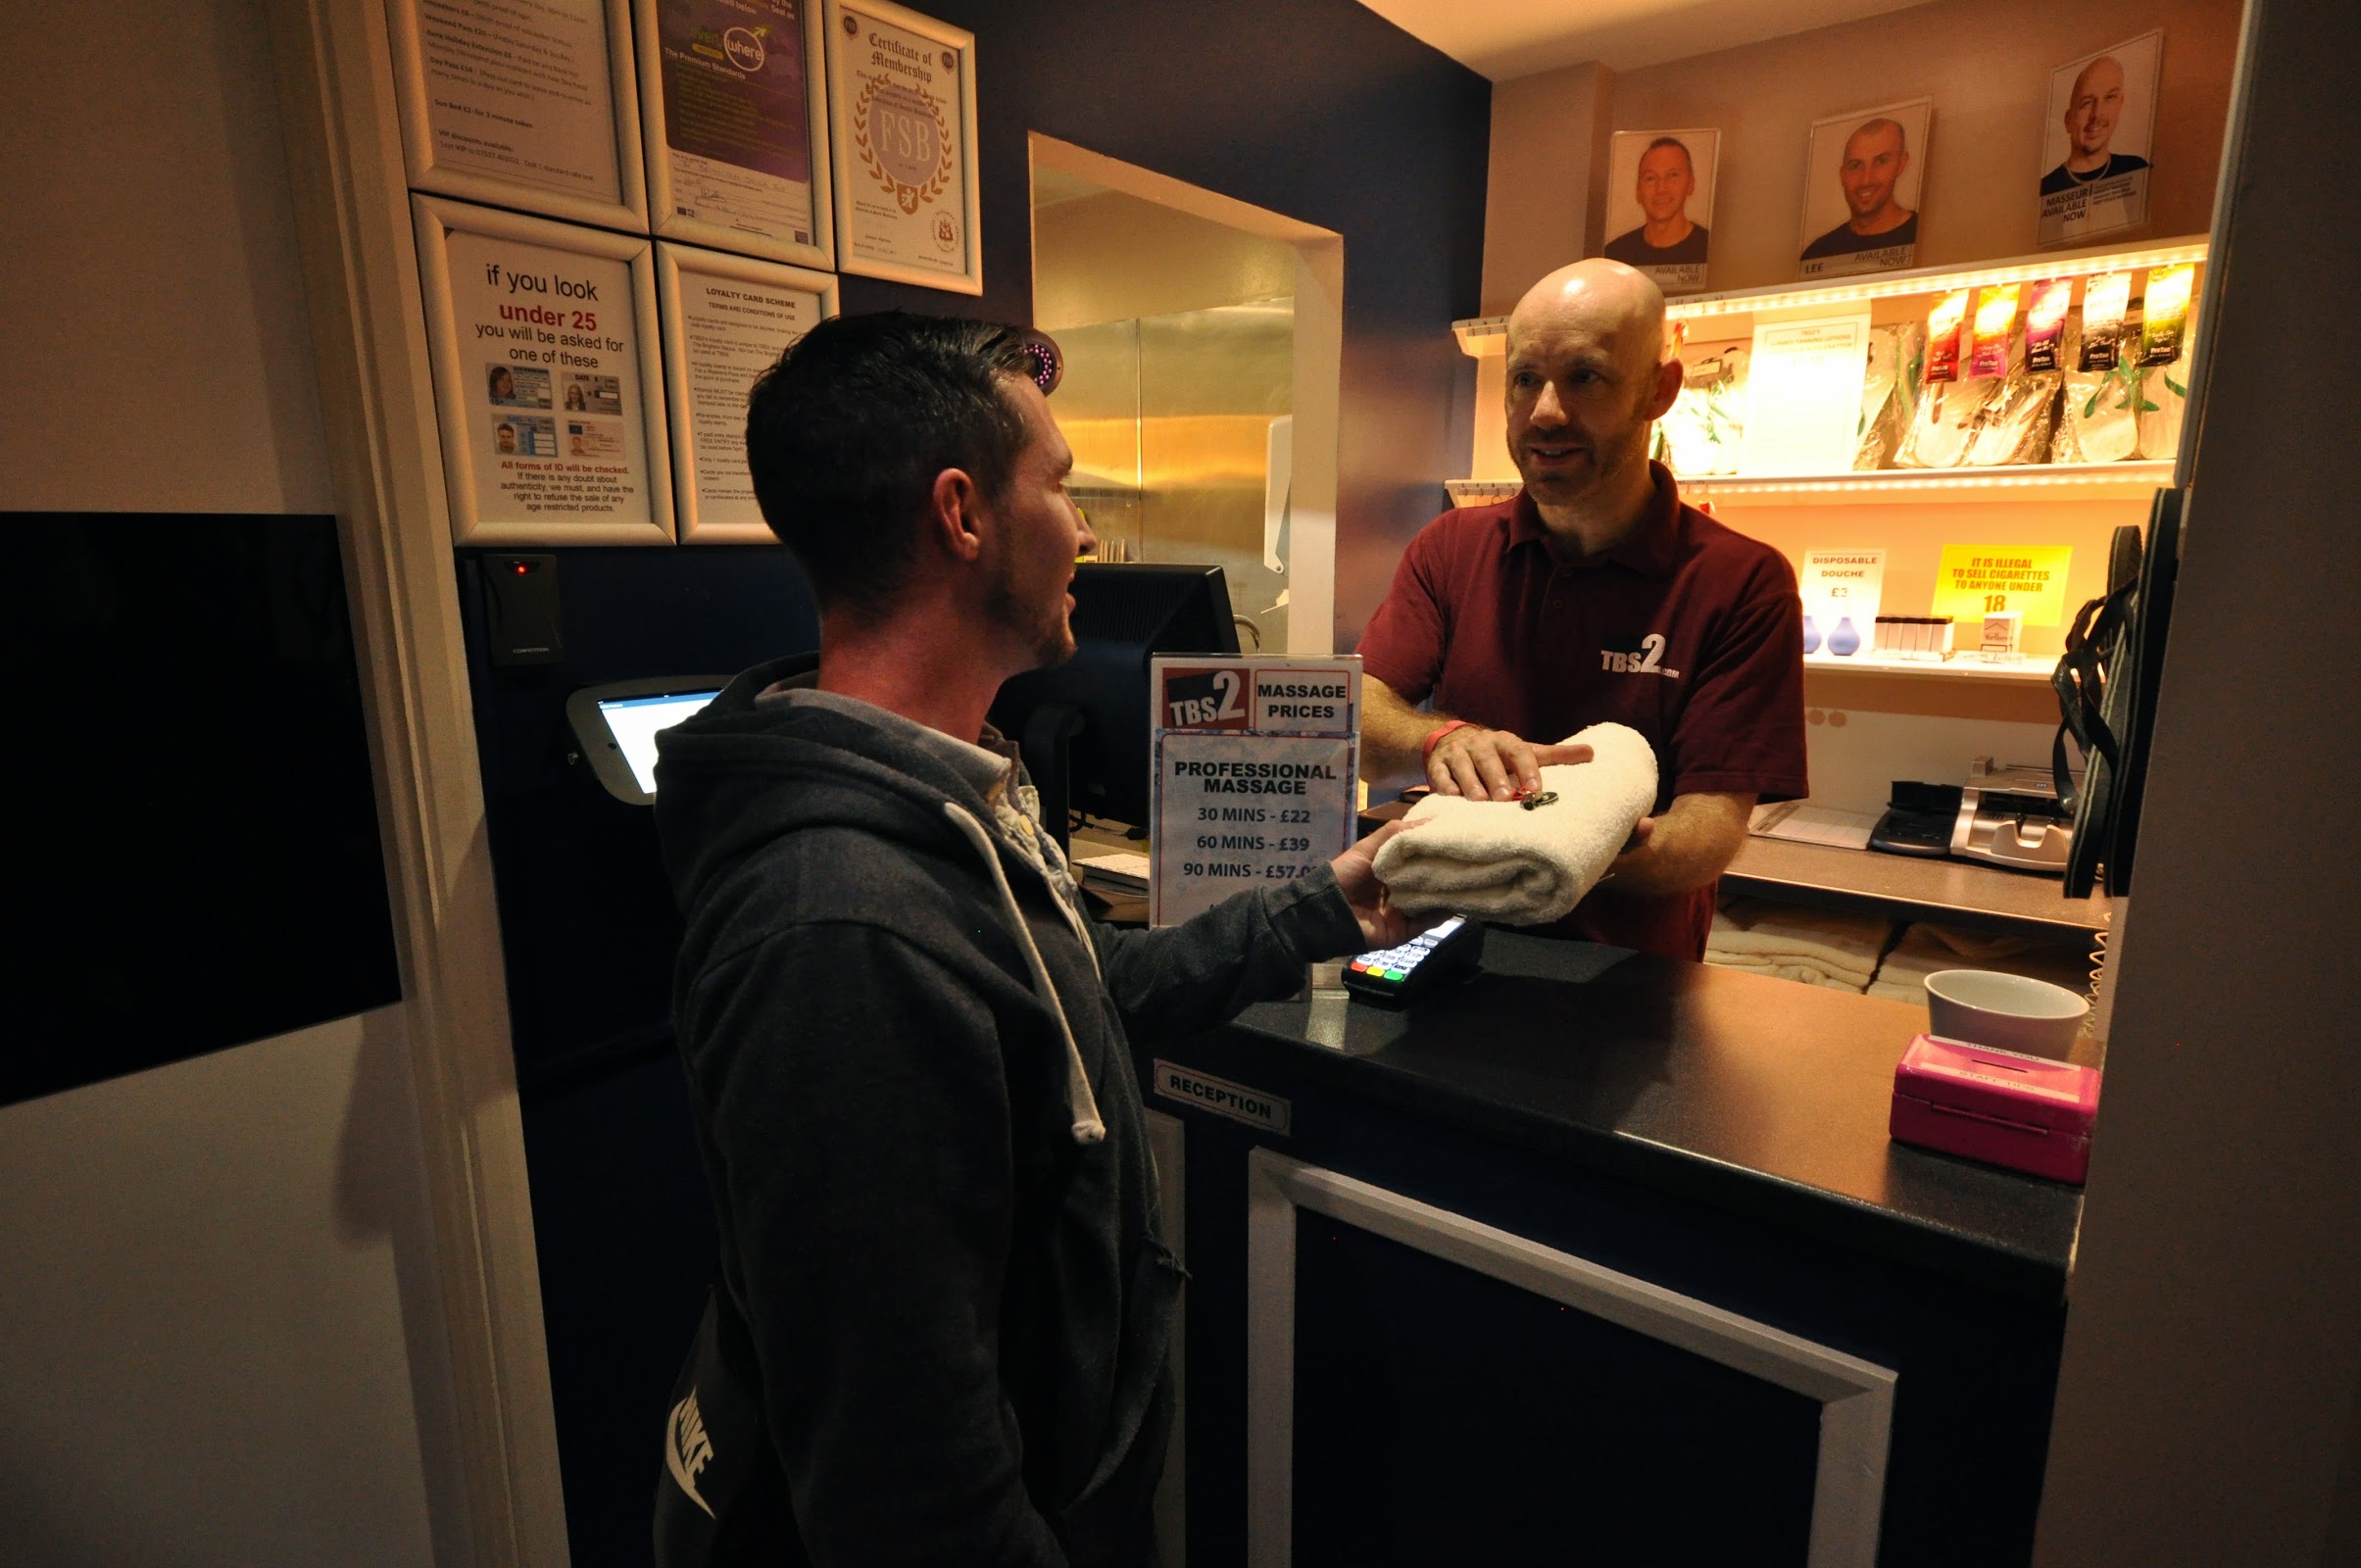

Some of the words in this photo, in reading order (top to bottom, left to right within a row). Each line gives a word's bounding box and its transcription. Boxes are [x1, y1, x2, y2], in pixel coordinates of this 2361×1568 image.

[726, 40, 762, 61] where
[868, 32, 920, 62] Certificate
[922, 52, 932, 67] of
[664, 47, 678, 58] The
[679, 53, 712, 69] Premium
[712, 63, 746, 80] Standards
[870, 51, 932, 84] Membership
[880, 109, 931, 162] FSB
[2045, 187, 2089, 207] MASSEUR
[2041, 199, 2088, 219] AVAILABLE
[2062, 209, 2087, 222] NOW
[1853, 246, 1907, 263] AVAILABLE
[1654, 265, 1700, 274] AVAILABLE
[1805, 263, 1824, 274] LEE
[1880, 255, 1906, 267] NOW
[486, 263, 500, 287] if
[507, 271, 548, 294] you
[554, 274, 599, 302] look
[1677, 273, 1700, 282] NOW
[706, 287, 741, 300] LOYALTY
[742, 294, 763, 305] CARD
[765, 297, 797, 310] SCHEME
[499, 305, 566, 327] under
[571, 311, 597, 331] 25
[708, 302, 729, 312] TERMS
[729, 305, 742, 314] AND
[742, 307, 776, 319] CONDITIONS
[784, 314, 796, 322] USE
[475, 323, 505, 339] you
[509, 326, 533, 341] will
[537, 328, 556, 344] be
[560, 334, 602, 351] asked
[605, 338, 624, 354] for
[509, 348, 537, 362] one
[542, 350, 557, 364] of
[560, 352, 600, 369] these
[501, 461, 514, 470] All
[516, 462, 541, 471] forms
[543, 462, 553, 471] of
[555, 463, 565, 472] ID
[566, 464, 581, 473] will
[582, 465, 593, 473] be
[594, 466, 630, 475] checked.
[517, 471, 524, 480] If
[524, 472, 546, 482] there
[557, 474, 572, 484] any
[573, 474, 595, 484] doubt
[596, 475, 618, 484] about
[585, 485, 602, 494] and
[602, 485, 621, 495] have
[622, 486, 635, 495] the
[513, 492, 533, 504] right
[534, 493, 543, 502] to
[544, 493, 568, 503] refuse
[568, 493, 584, 503] the
[584, 494, 601, 503] sale
[611, 496, 626, 506] any
[525, 504, 543, 513] age
[543, 502, 579, 512] restricted
[1972, 558, 1983, 567] IT
[1983, 558, 1993, 567] IS
[1994, 559, 2033, 568] ILLEGAL
[1952, 568, 1965, 578] TO
[1966, 568, 1988, 579] SELL
[1990, 569, 2050, 581] CIGARETTES
[1831, 587, 1848, 598] £3
[1955, 579, 1968, 590] TO
[1968, 580, 2008, 591] ANYONE
[2008, 581, 2042, 592] UNDER
[1984, 594, 2006, 612] 18
[1169, 670, 1246, 726] TBS2
[1257, 684, 1347, 699] MASSAGE
[1268, 705, 1335, 718] PRICES
[1175, 761, 1337, 780] PROFESSIONAL
[1204, 779, 1306, 795] MASSAGE
[1198, 808, 1218, 821] 30
[1222, 808, 1265, 822] MINS
[1280, 809, 1310, 823] £22
[1197, 836, 1217, 850] 60
[1221, 836, 1265, 850] MINS
[1278, 838, 1309, 852] £39
[1183, 862, 1205, 876] 90
[1208, 863, 1252, 878] MINS
[1265, 865, 1317, 879] £57.0
[1968, 1043, 2007, 1054] THANK
[2013, 1052, 2041, 1061] YOU
[1169, 1074, 1272, 1120] RECEPTION
